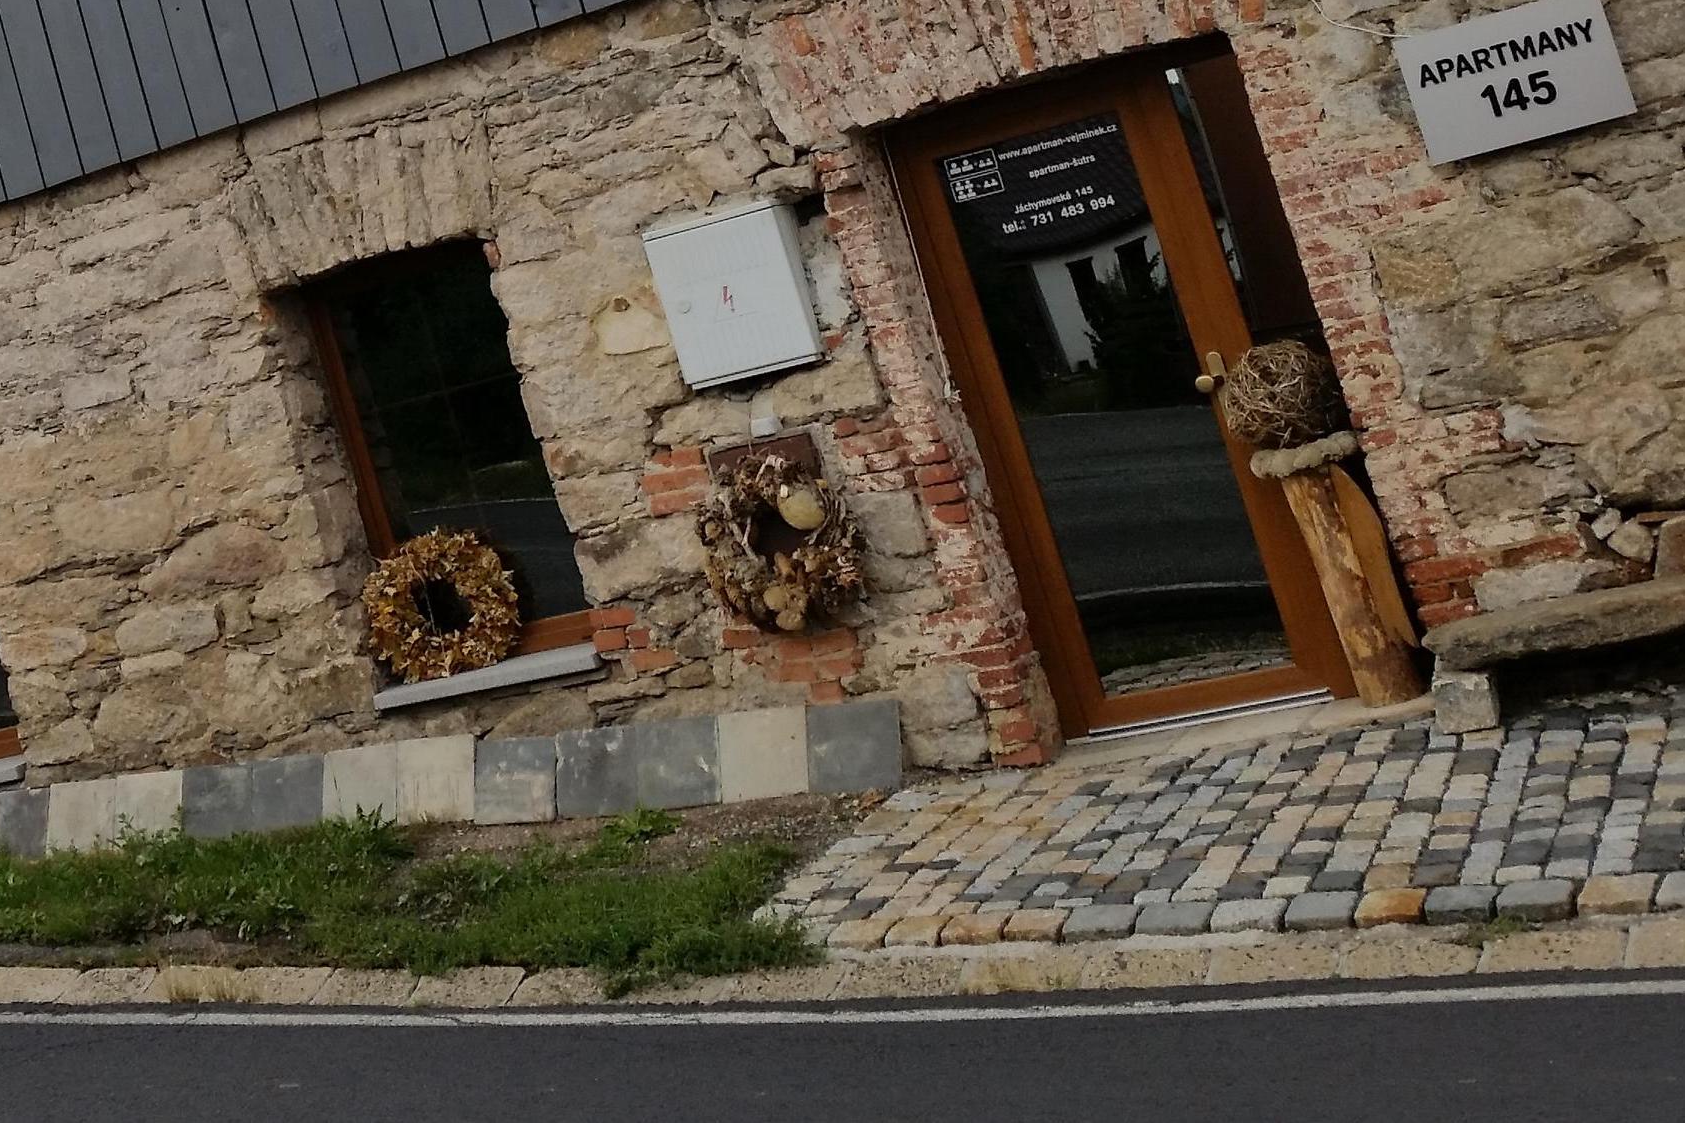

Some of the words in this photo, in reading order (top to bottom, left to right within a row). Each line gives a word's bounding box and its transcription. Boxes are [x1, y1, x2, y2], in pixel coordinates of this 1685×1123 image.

[1420, 18, 1593, 88] APARTMANY
[1480, 70, 1557, 117] 145
[1014, 191, 1072, 214] Jáchymovská
[1075, 185, 1094, 197] 145
[1030, 211, 1054, 227] 731
[1061, 203, 1085, 218] 483
[1090, 194, 1115, 211] 994
